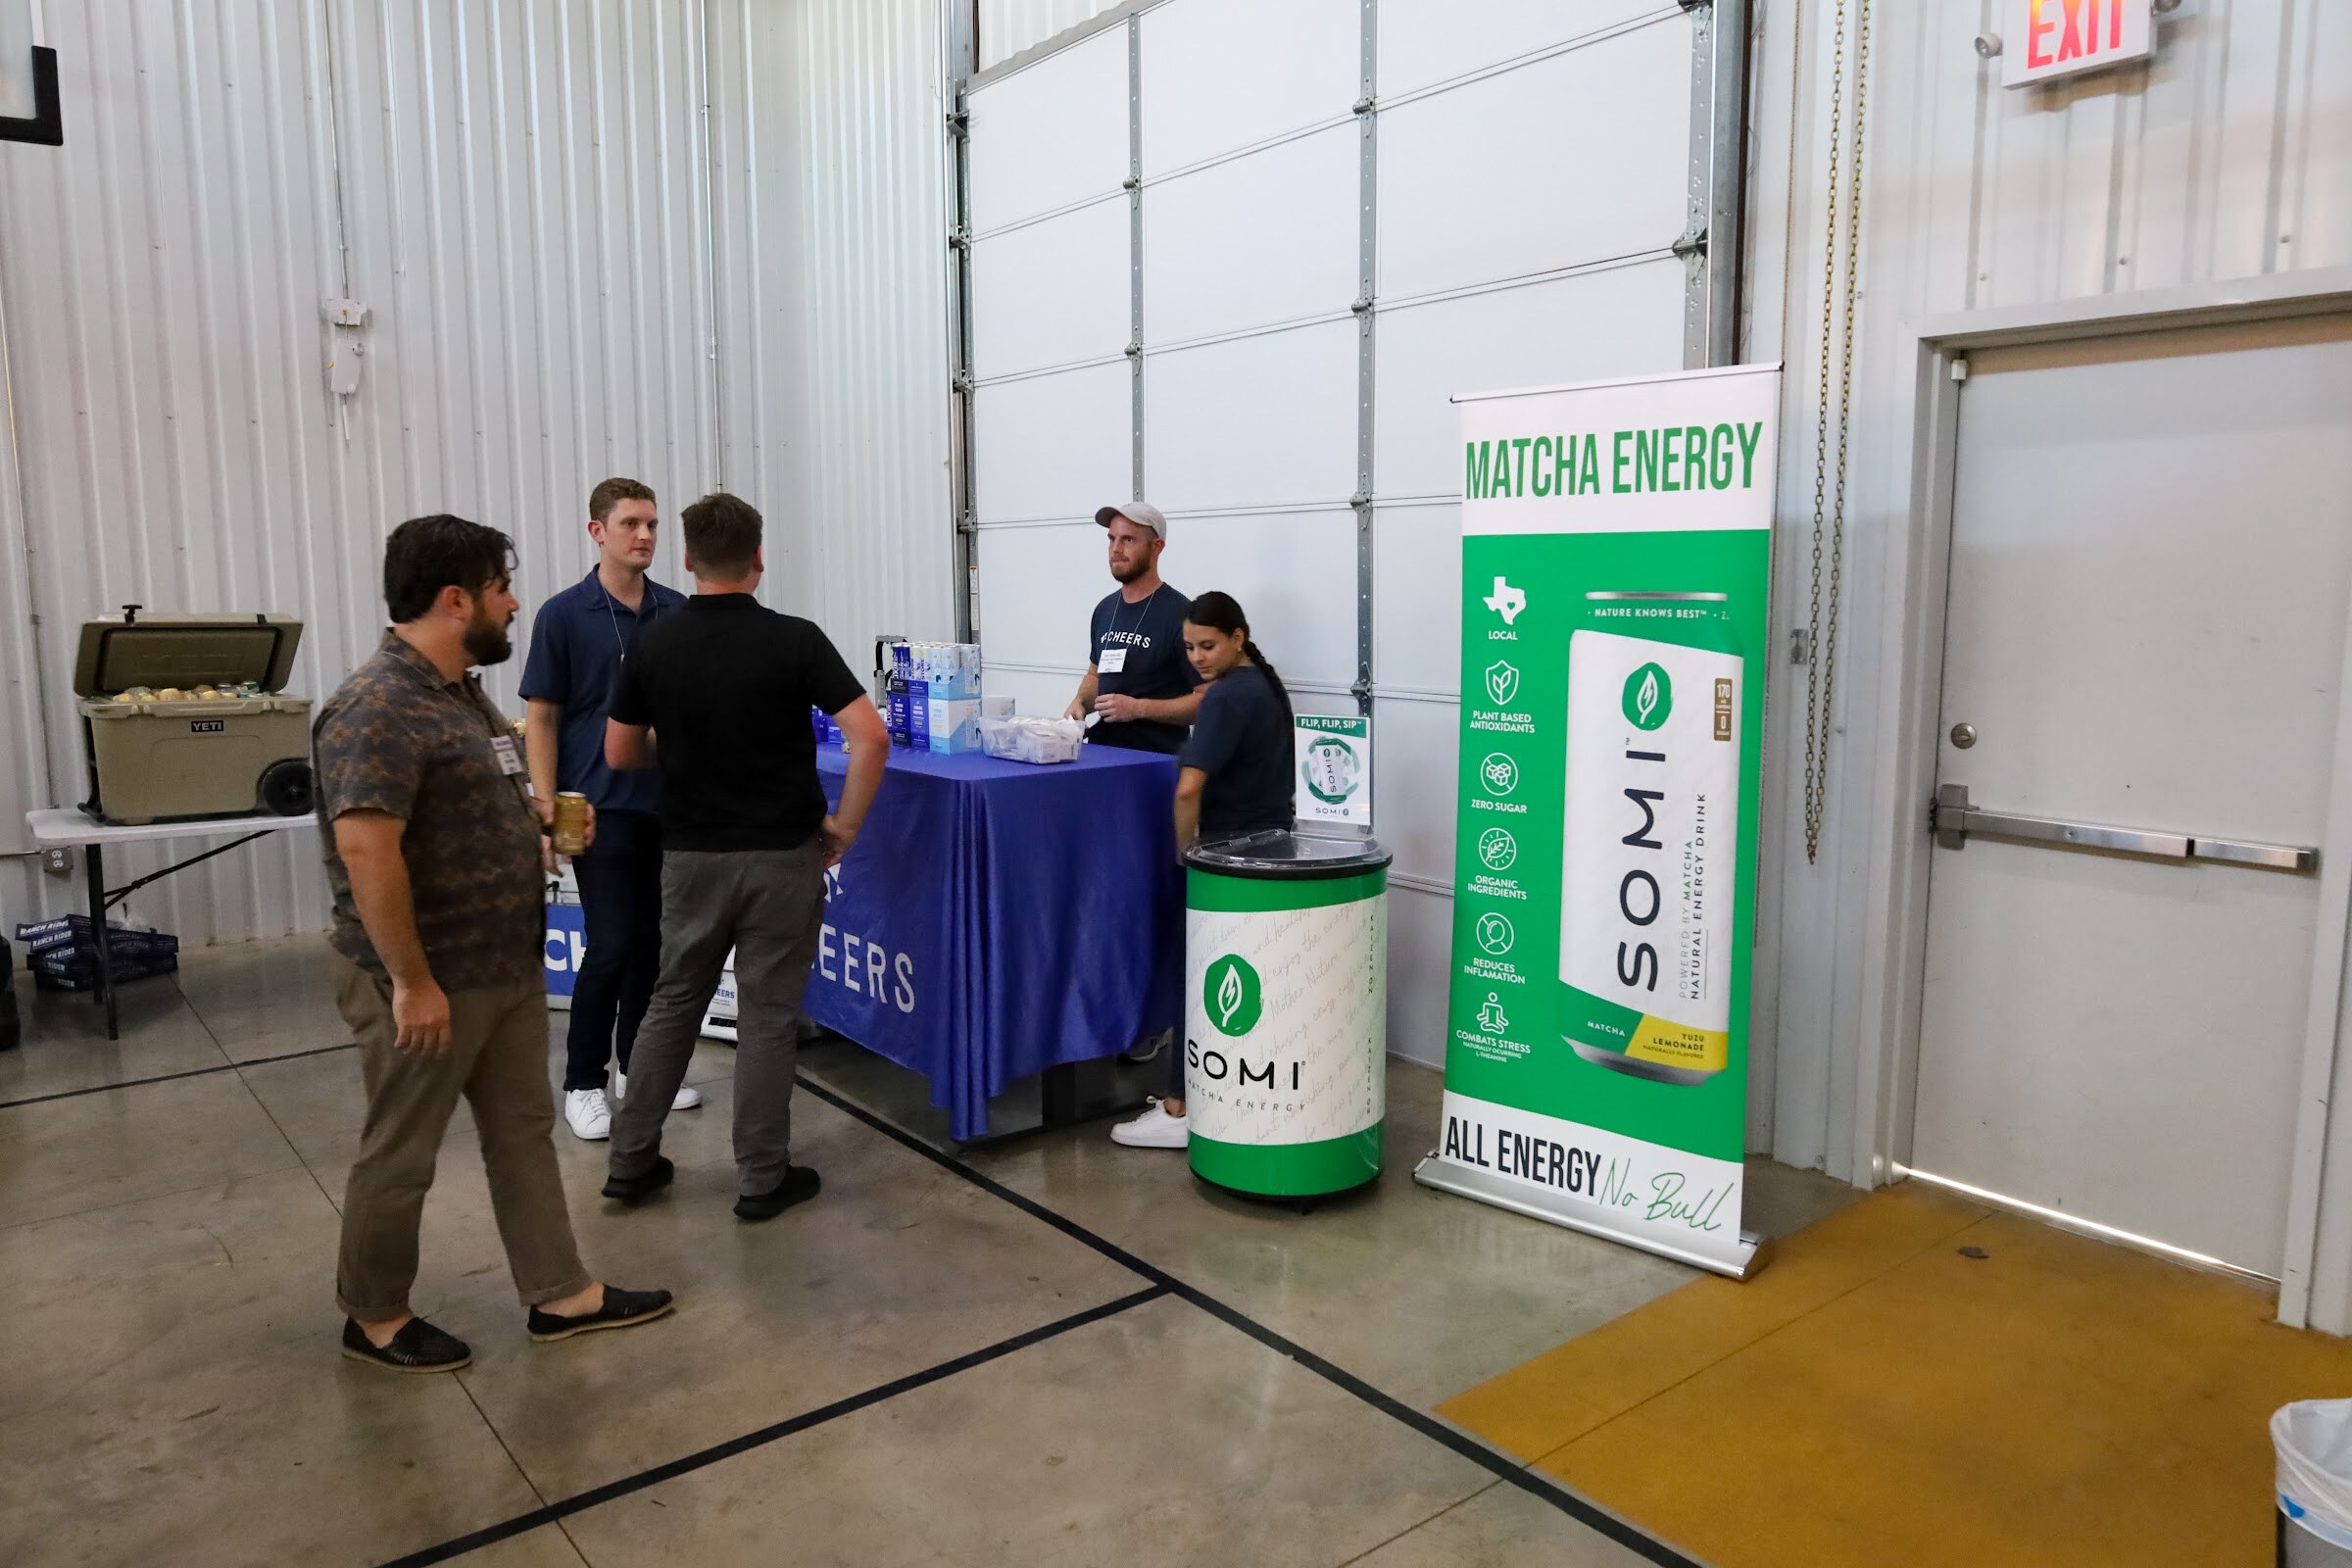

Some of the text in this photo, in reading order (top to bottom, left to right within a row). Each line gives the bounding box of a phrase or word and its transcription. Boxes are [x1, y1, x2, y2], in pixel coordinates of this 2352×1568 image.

[1466, 421, 1763, 500] MATCHA ENERGY
[1594, 609, 1632, 617] NATURE
[1635, 609, 1672, 618] KNOWS
[1108, 631, 1151, 649] CHEERS
[1488, 631, 1518, 641] LOCAL
[1716, 684, 1731, 698] 170
[1300, 718, 1321, 729] FLIP,
[1322, 720, 1343, 730] FLIP,
[1473, 710, 1532, 723] PLANT BASED
[193, 722, 222, 731] YETI
[1470, 720, 1535, 733] ANTIOXIDANTS
[1471, 799, 1527, 813] ZERO SUGAR
[1475, 875, 1518, 889] ORGANIC
[1467, 883, 1527, 900] INGREDIENTS
[1690, 793, 1706, 1000] NATURAL ENERGY DRINK
[1679, 841, 1693, 999] POWERED BY MATCHA
[20, 924, 47, 935] RANCH
[32, 930, 73, 948] RANCH RIDER
[817, 922, 915, 1013] EERS
[1473, 957, 1515, 972] REDUCES
[1464, 965, 1525, 984] INFLAMATION
[716, 989, 735, 999] EERS
[1270, 983, 1304, 1020] Mother
[1587, 1021, 1626, 1037] MATCHA
[1456, 1030, 1531, 1054] COMBATS STRESS
[1652, 1037, 1704, 1052] LEMONADE
[1682, 1033, 1705, 1043] YUZU
[1236, 1098, 1306, 1112] ENERGY
[1445, 1115, 1735, 1231] ALL ENERGY No Bull
